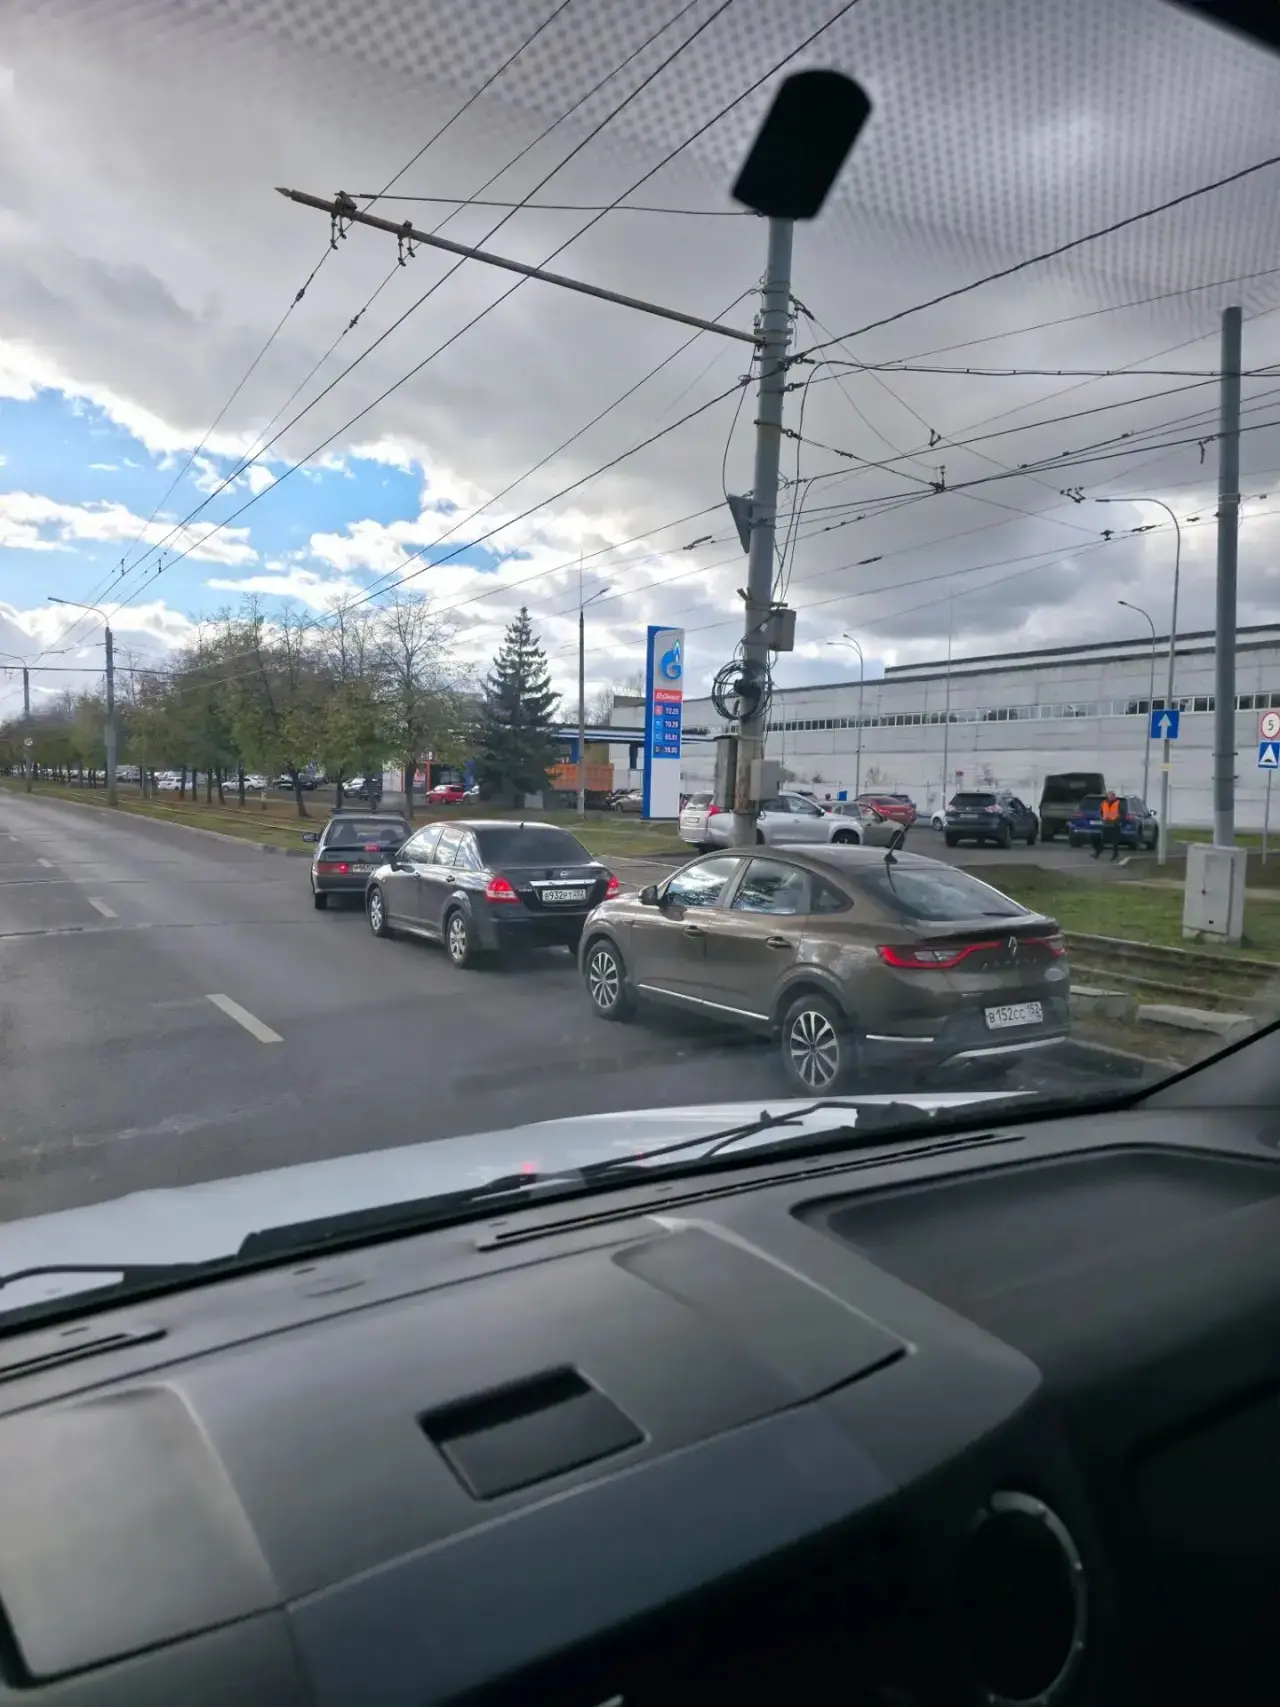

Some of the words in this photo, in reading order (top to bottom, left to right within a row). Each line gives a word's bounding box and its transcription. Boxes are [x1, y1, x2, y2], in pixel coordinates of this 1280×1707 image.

[1268, 720, 1274, 731] 5
[988, 1007, 1026, 1023] В152СС
[1027, 1004, 1039, 1016] 152
